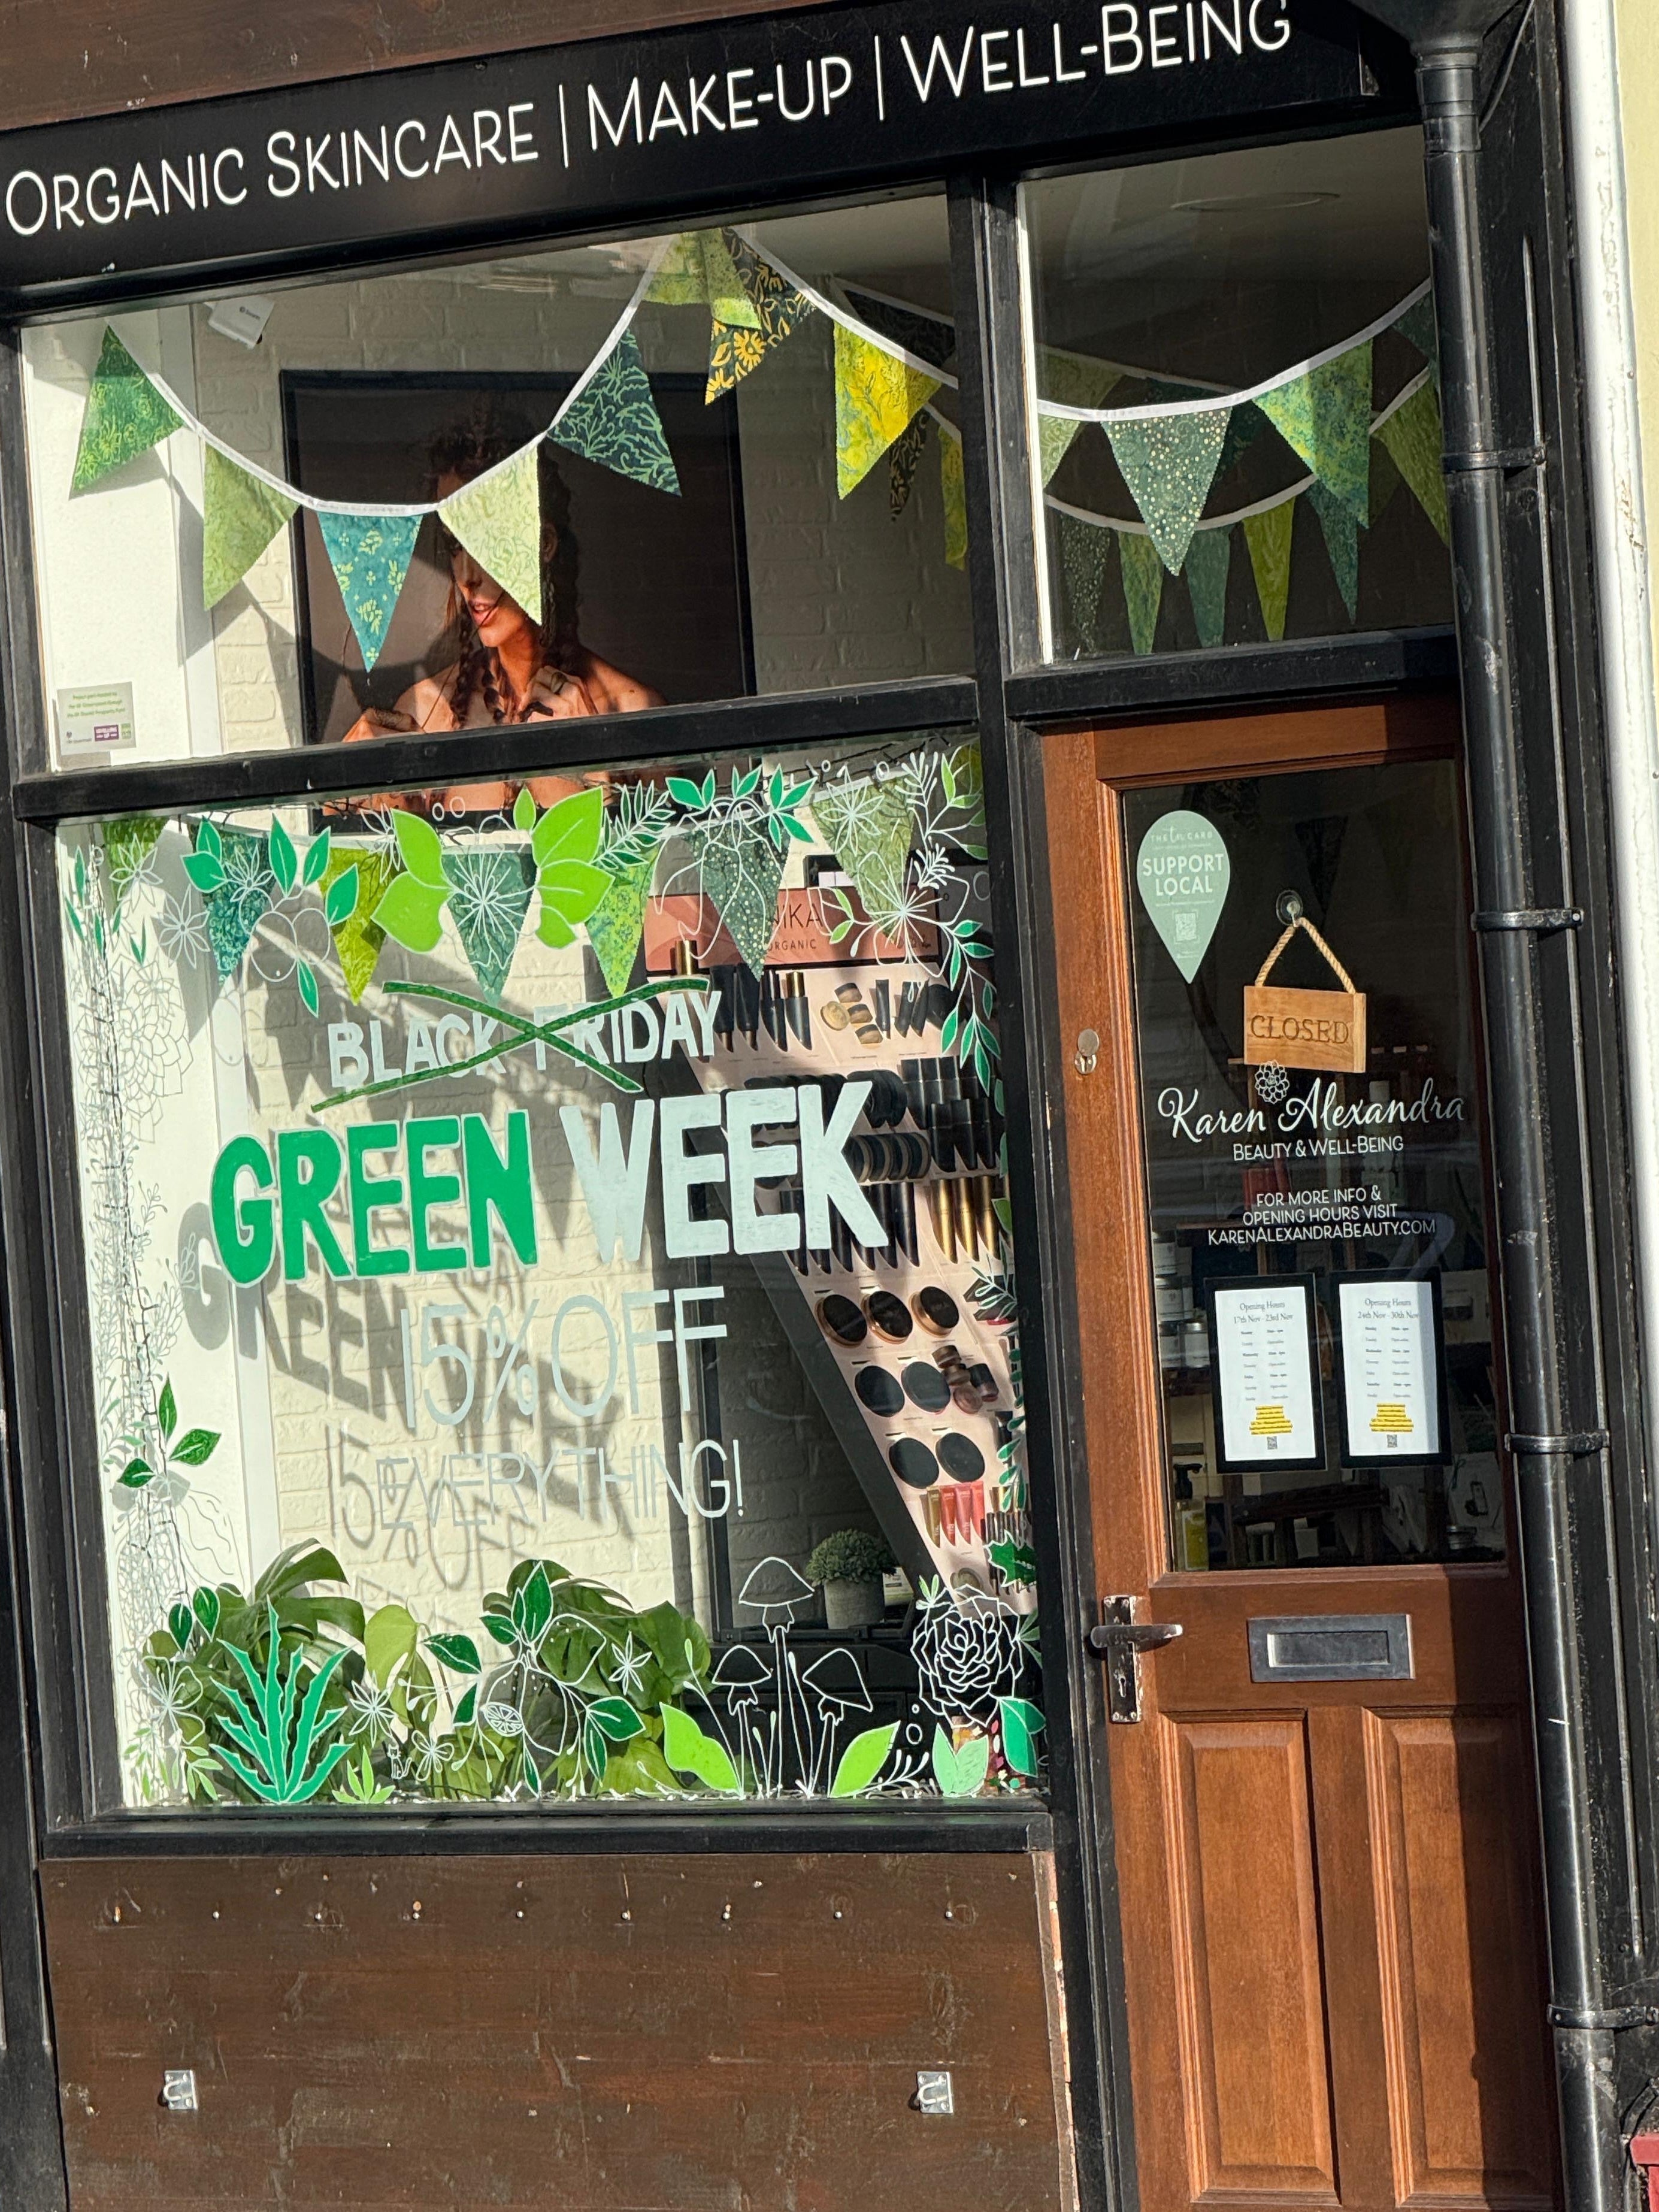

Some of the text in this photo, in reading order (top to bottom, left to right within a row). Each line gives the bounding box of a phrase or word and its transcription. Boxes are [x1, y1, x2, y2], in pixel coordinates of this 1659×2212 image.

[1143, 854, 1224, 876] SUPPORT
[1155, 875, 1213, 897] LOCAL
[327, 991, 722, 1089] BLACK FRIDAY
[1250, 1015, 1350, 1045] CLOSED
[1158, 1077, 1465, 1143] Karen Alexandra
[1233, 1135, 1404, 1161] BEAUTY & WELL-BEING
[210, 1081, 889, 1289] GREEN WEEK
[1257, 1184, 1382, 1208] FOR MORE INFO &
[1242, 1203, 1398, 1226] OPENING HOURS VISIT
[1239, 1302, 1265, 1312] Opening
[1364, 1298, 1391, 1308] Opening
[400, 1285, 728, 1428] 15% OFF
[375, 1439, 744, 1531] EVERYTHING!
